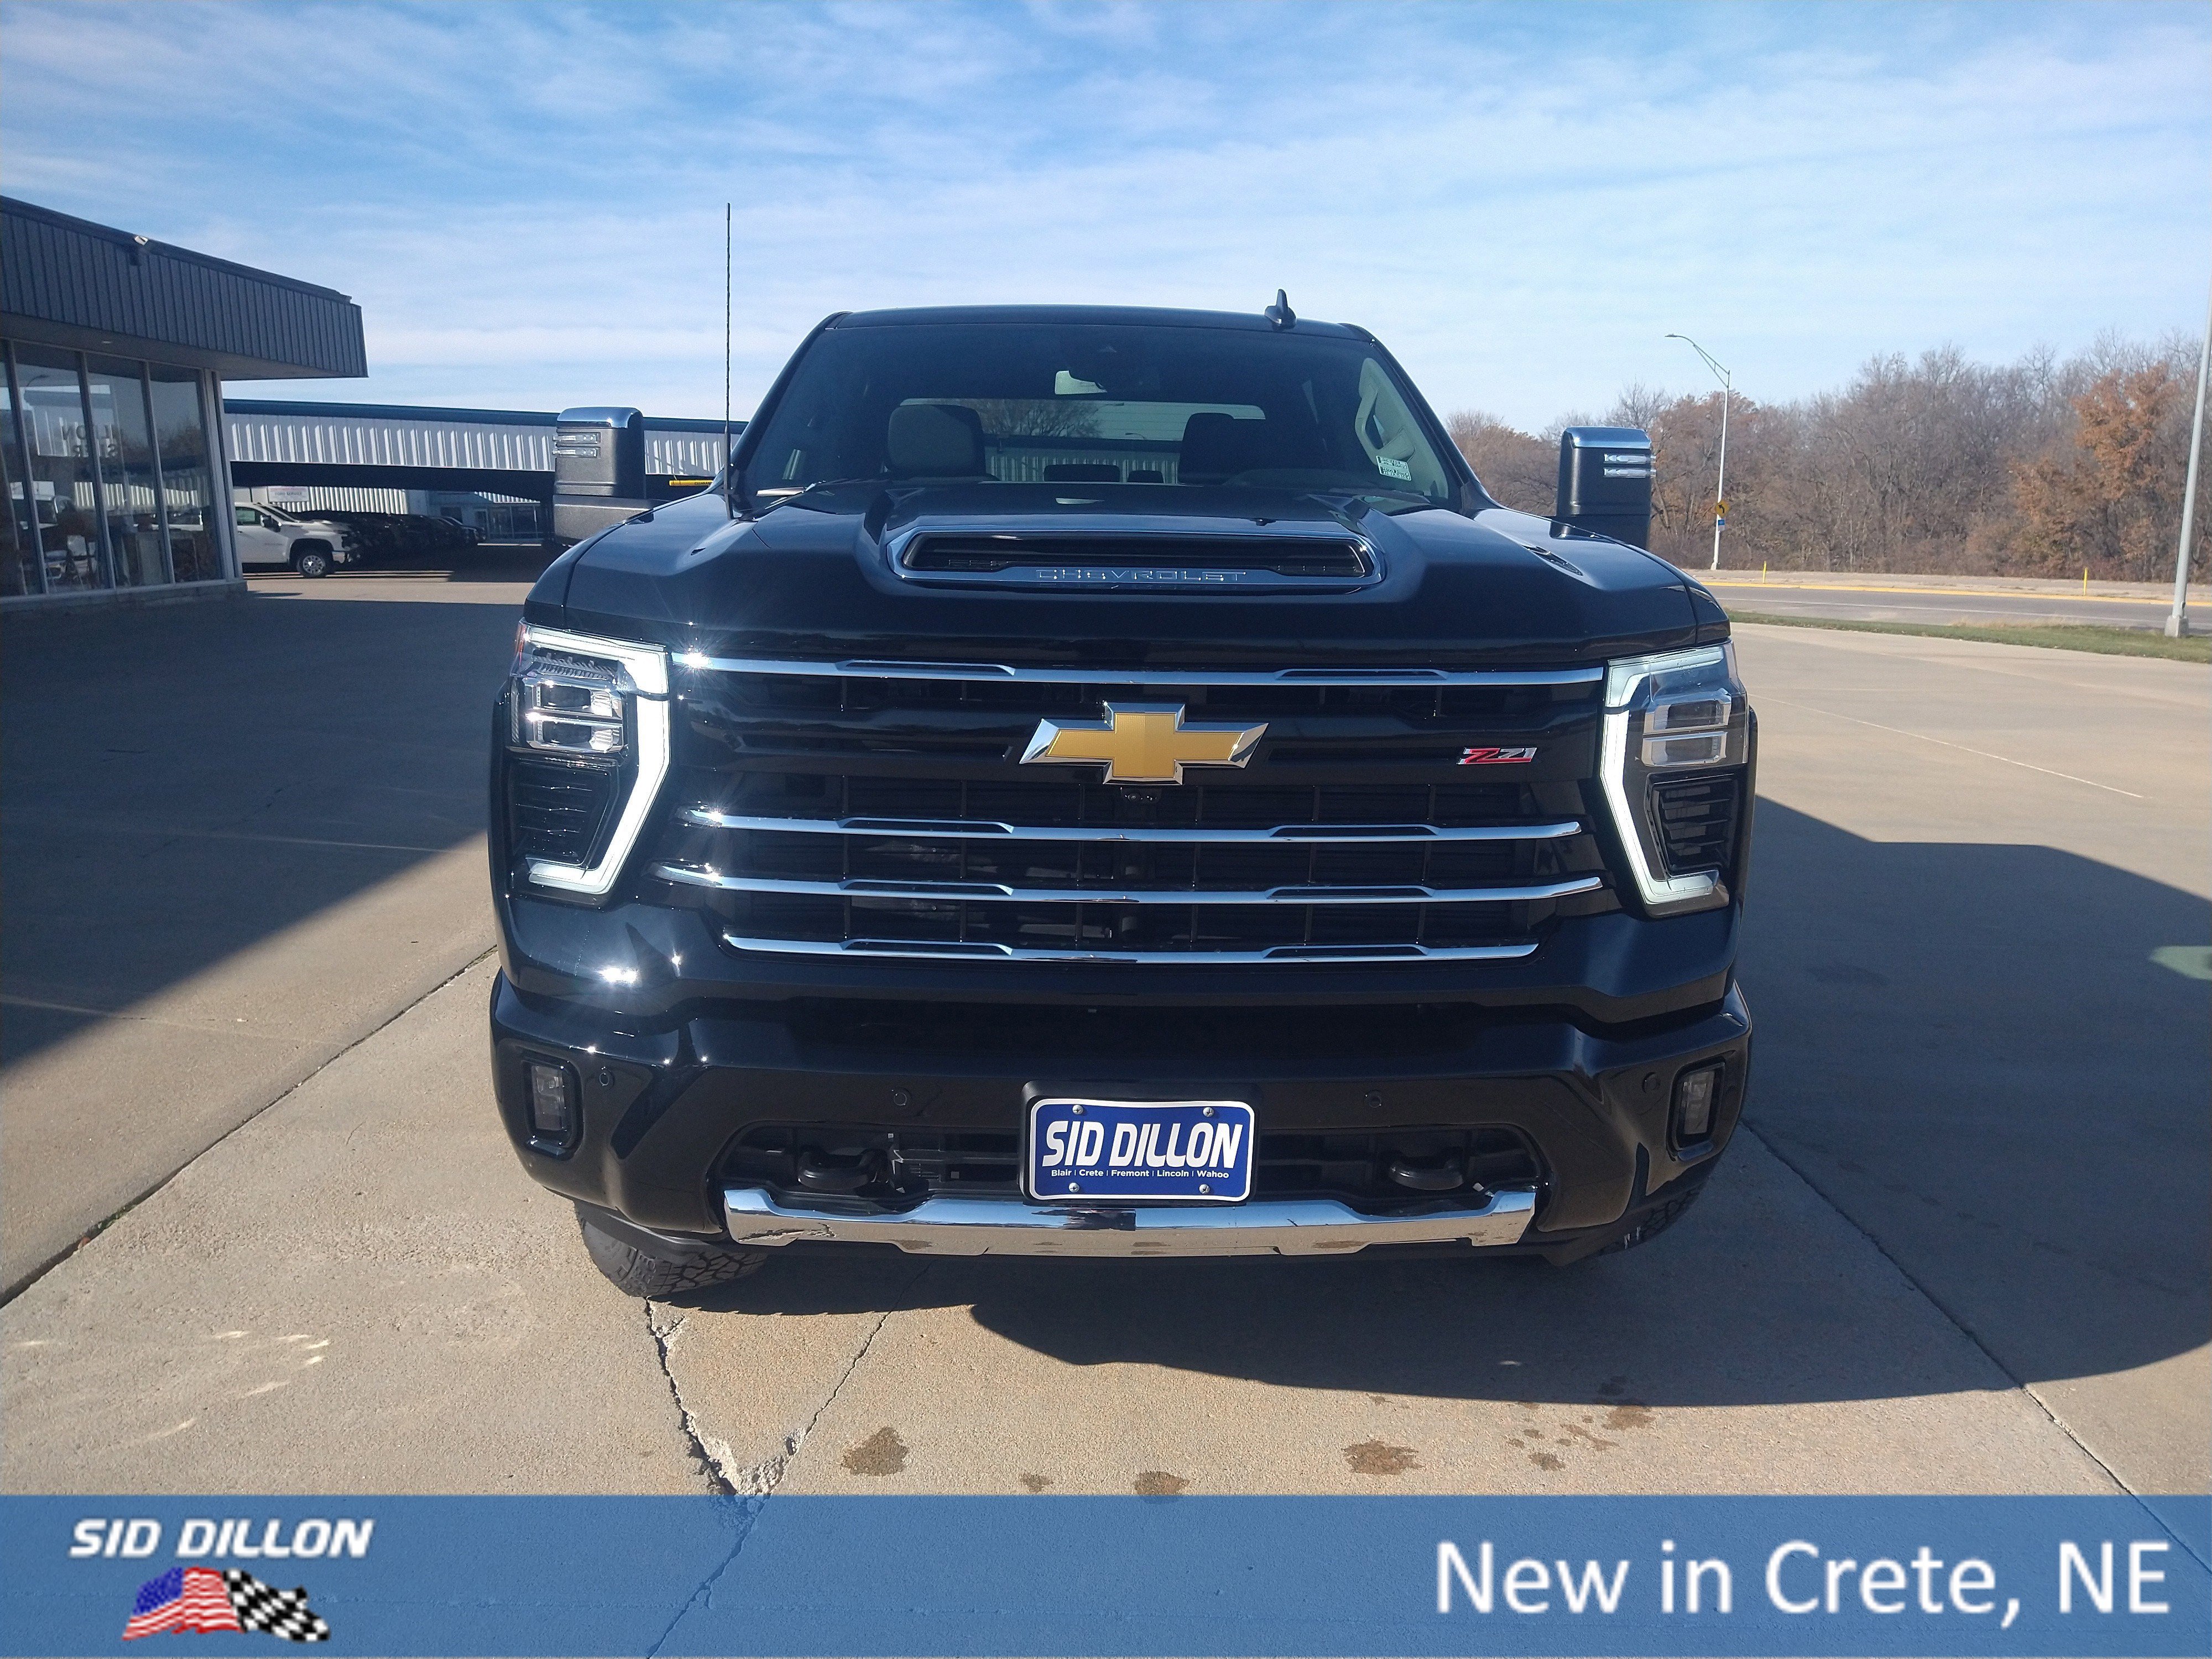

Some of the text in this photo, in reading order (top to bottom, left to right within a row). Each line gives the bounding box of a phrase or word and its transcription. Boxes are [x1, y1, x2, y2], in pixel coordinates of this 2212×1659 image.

[1035, 568, 1246, 582] CHEVROLET
[1456, 747, 1537, 765] Z71
[1042, 1120, 1244, 1168] SID DILLON
[1051, 1168, 1230, 1178] Blair Crete Fremont Lincoln Wahoo
